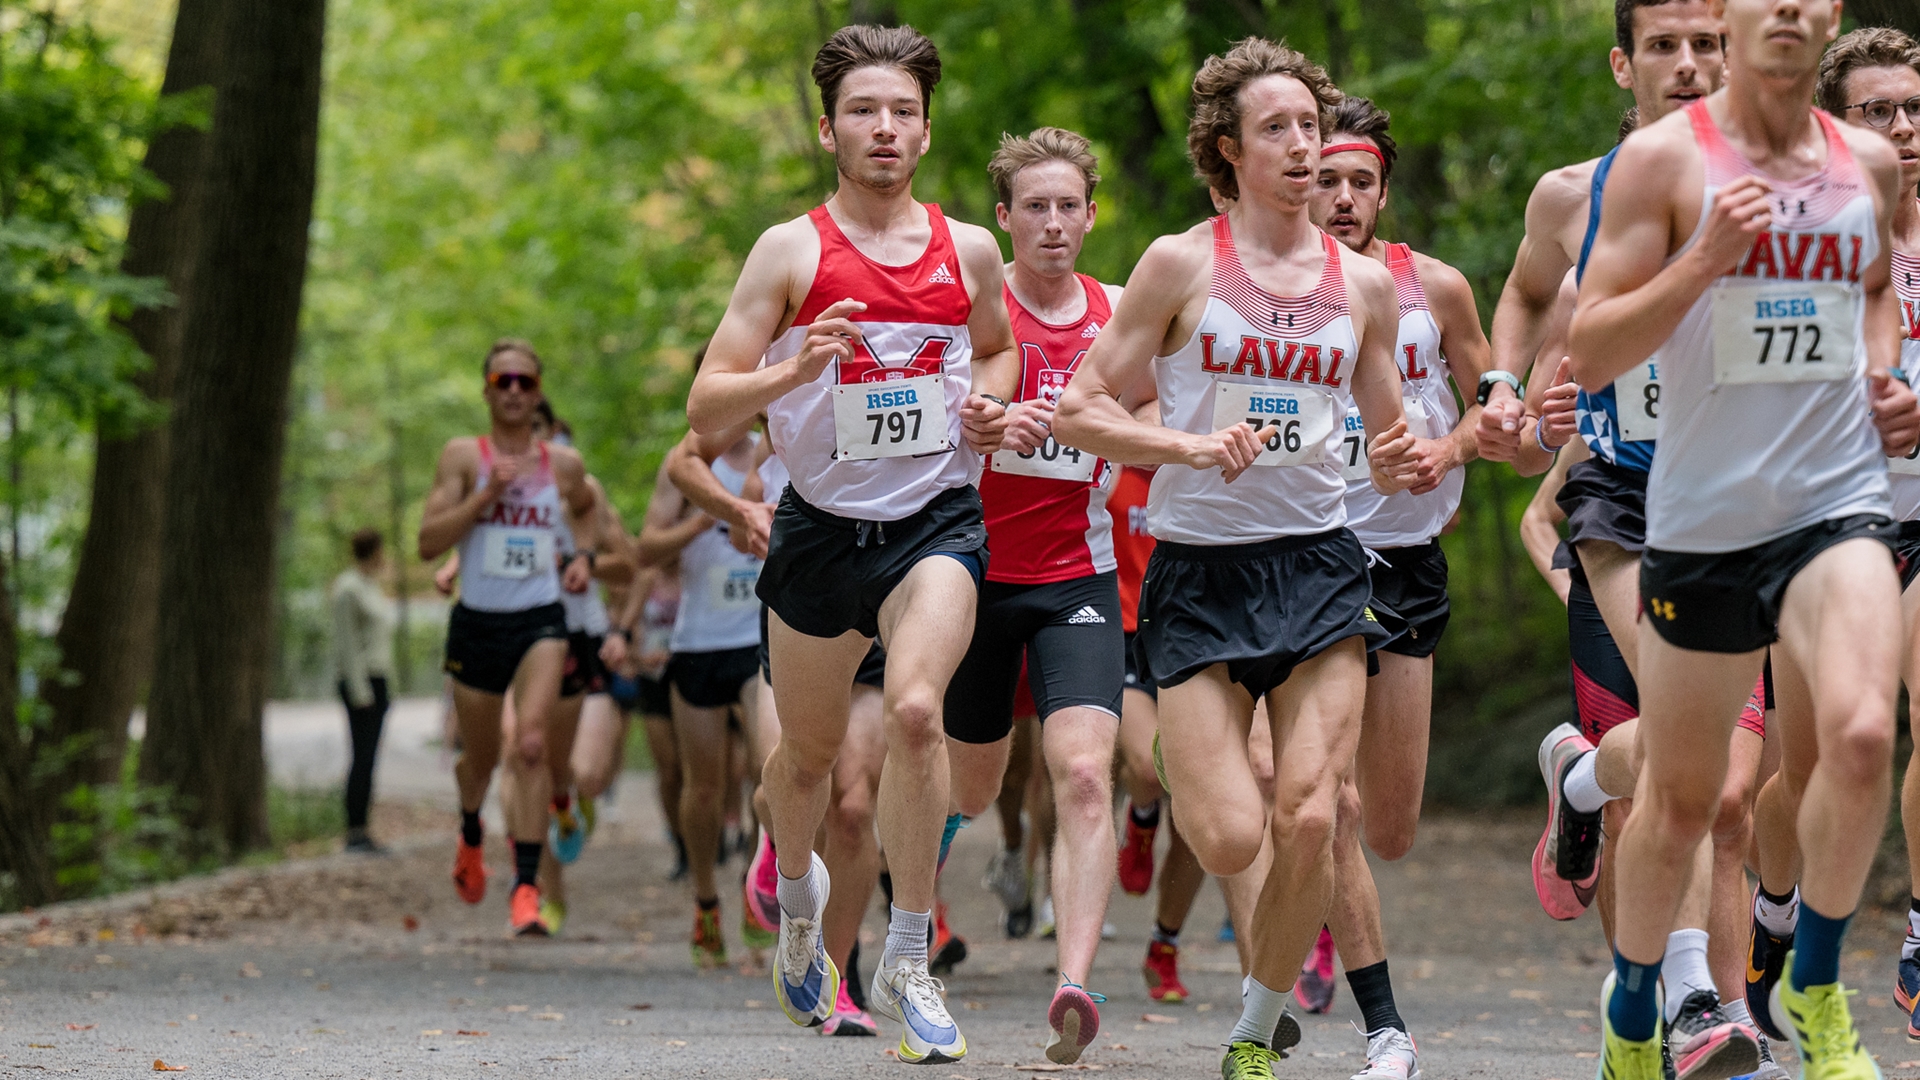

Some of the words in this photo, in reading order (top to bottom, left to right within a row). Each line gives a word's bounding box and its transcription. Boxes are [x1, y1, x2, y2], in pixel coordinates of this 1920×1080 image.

[1722, 231, 1862, 283] AVAL
[928, 275, 956, 285] adidas
[1754, 297, 1817, 319] RSEQ
[1753, 324, 1823, 365] 772
[1200, 332, 1345, 389] LAVAL
[866, 388, 919, 409] RSEQ
[1248, 397, 1299, 414] RSEQ
[866, 408, 922, 446] 797
[1068, 615, 1106, 624] adidas
